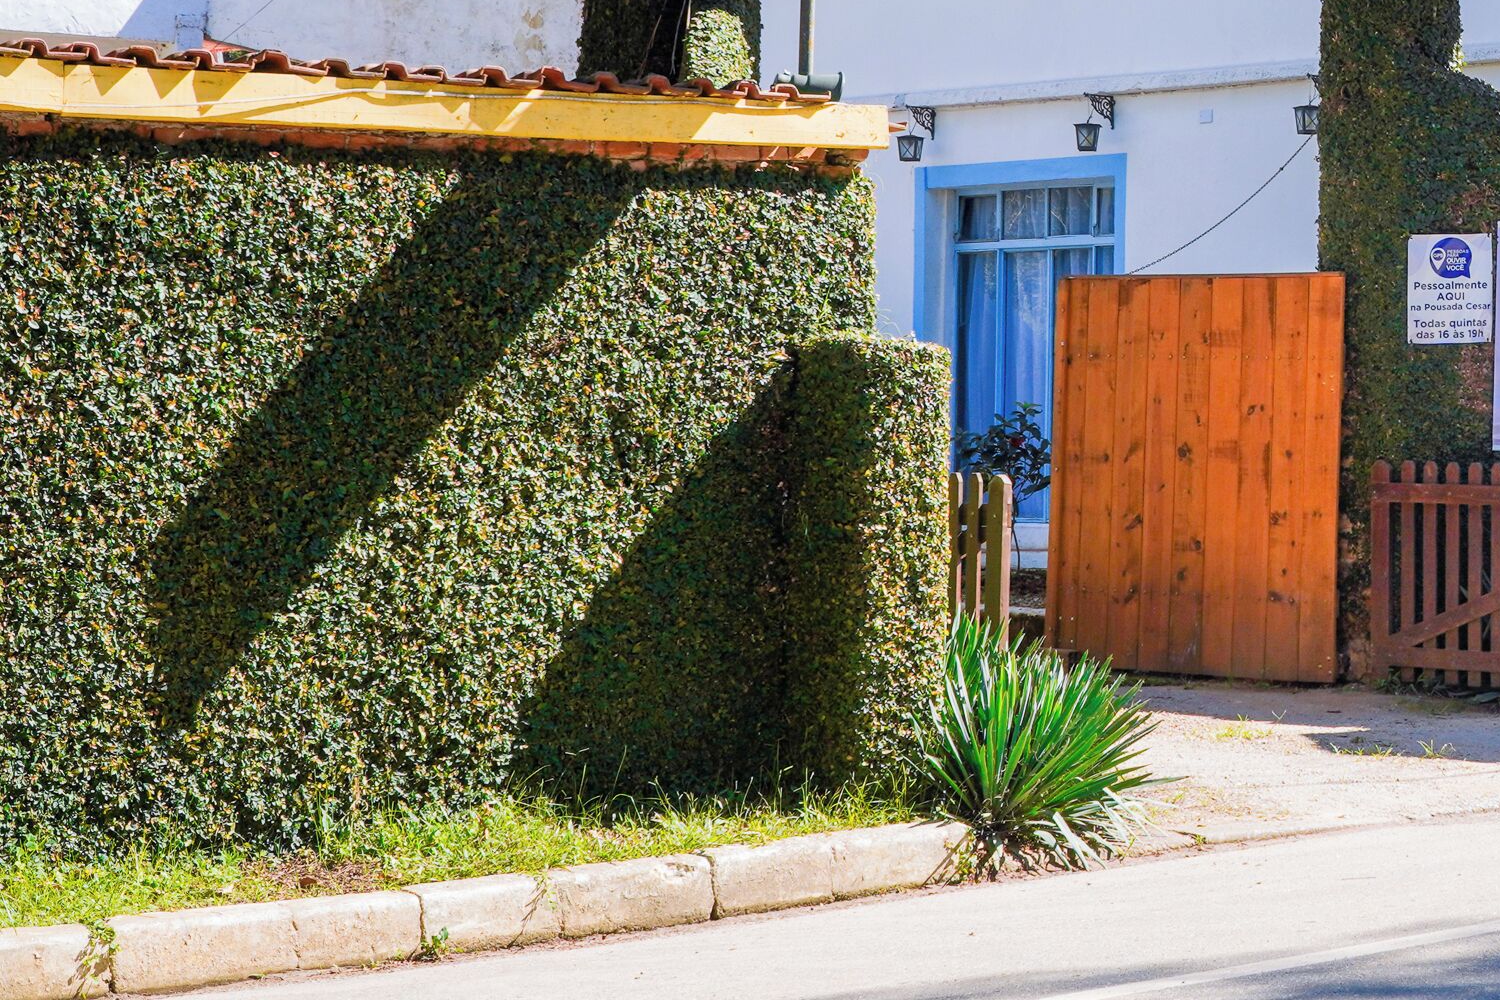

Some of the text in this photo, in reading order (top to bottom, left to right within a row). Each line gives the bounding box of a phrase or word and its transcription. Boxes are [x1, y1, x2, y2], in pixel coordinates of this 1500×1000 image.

[1414, 281, 1488, 290] Pessoalmente
[1437, 292, 1465, 300] AQUI
[1414, 319, 1487, 329] Todas quintas
[1438, 330, 1450, 338] 16
[1453, 330, 1464, 338] às
[1468, 329, 1484, 338] 19h
